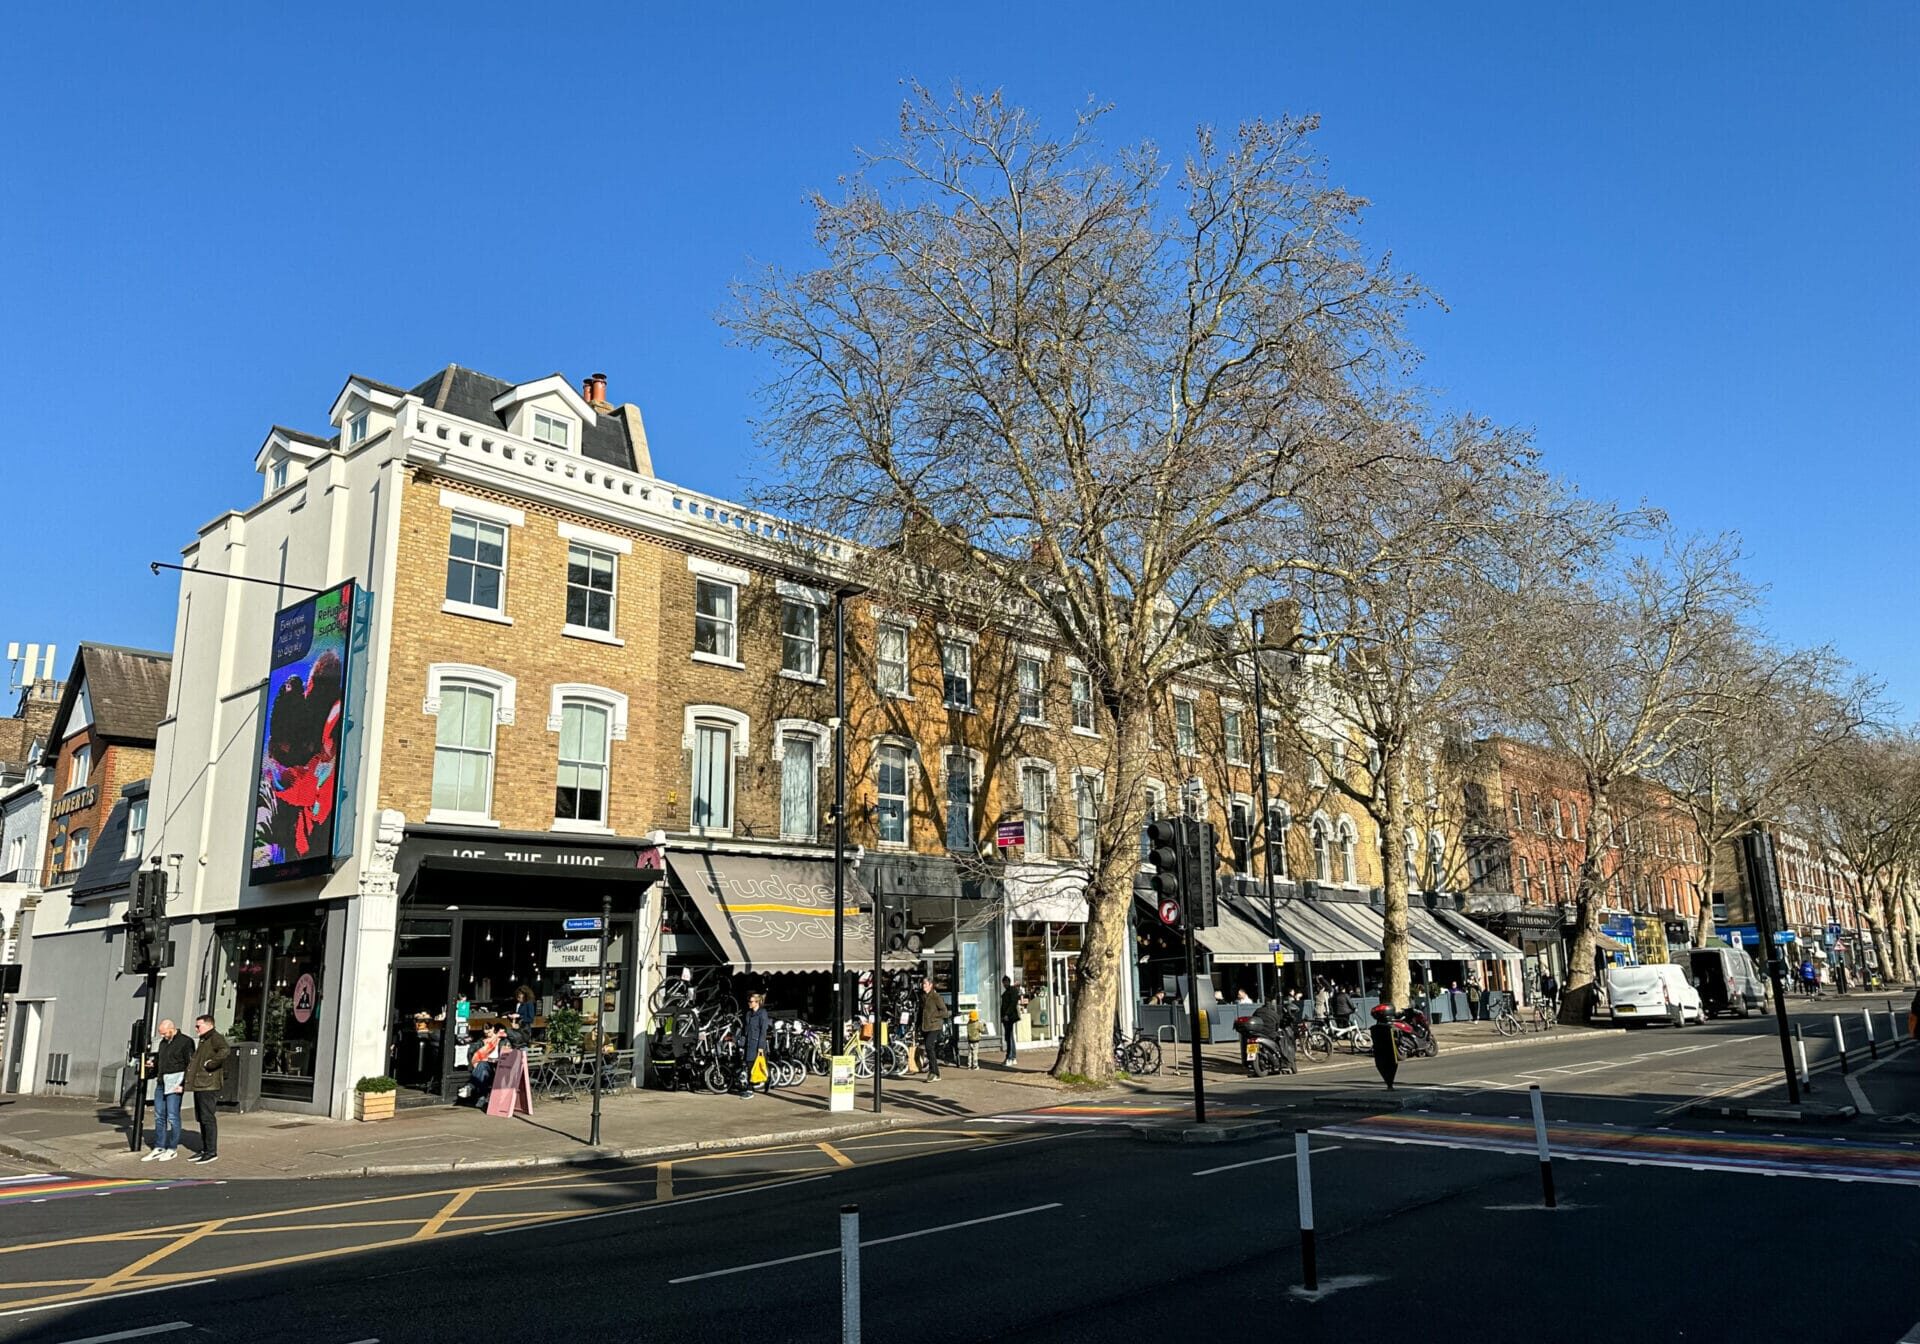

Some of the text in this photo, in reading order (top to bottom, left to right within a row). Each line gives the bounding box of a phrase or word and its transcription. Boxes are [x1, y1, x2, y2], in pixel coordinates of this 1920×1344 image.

[696, 870, 853, 906] Fudges
[729, 914, 875, 942] Cycles
[579, 944, 598, 953] GREEN
[562, 954, 586, 963] TERRACE
